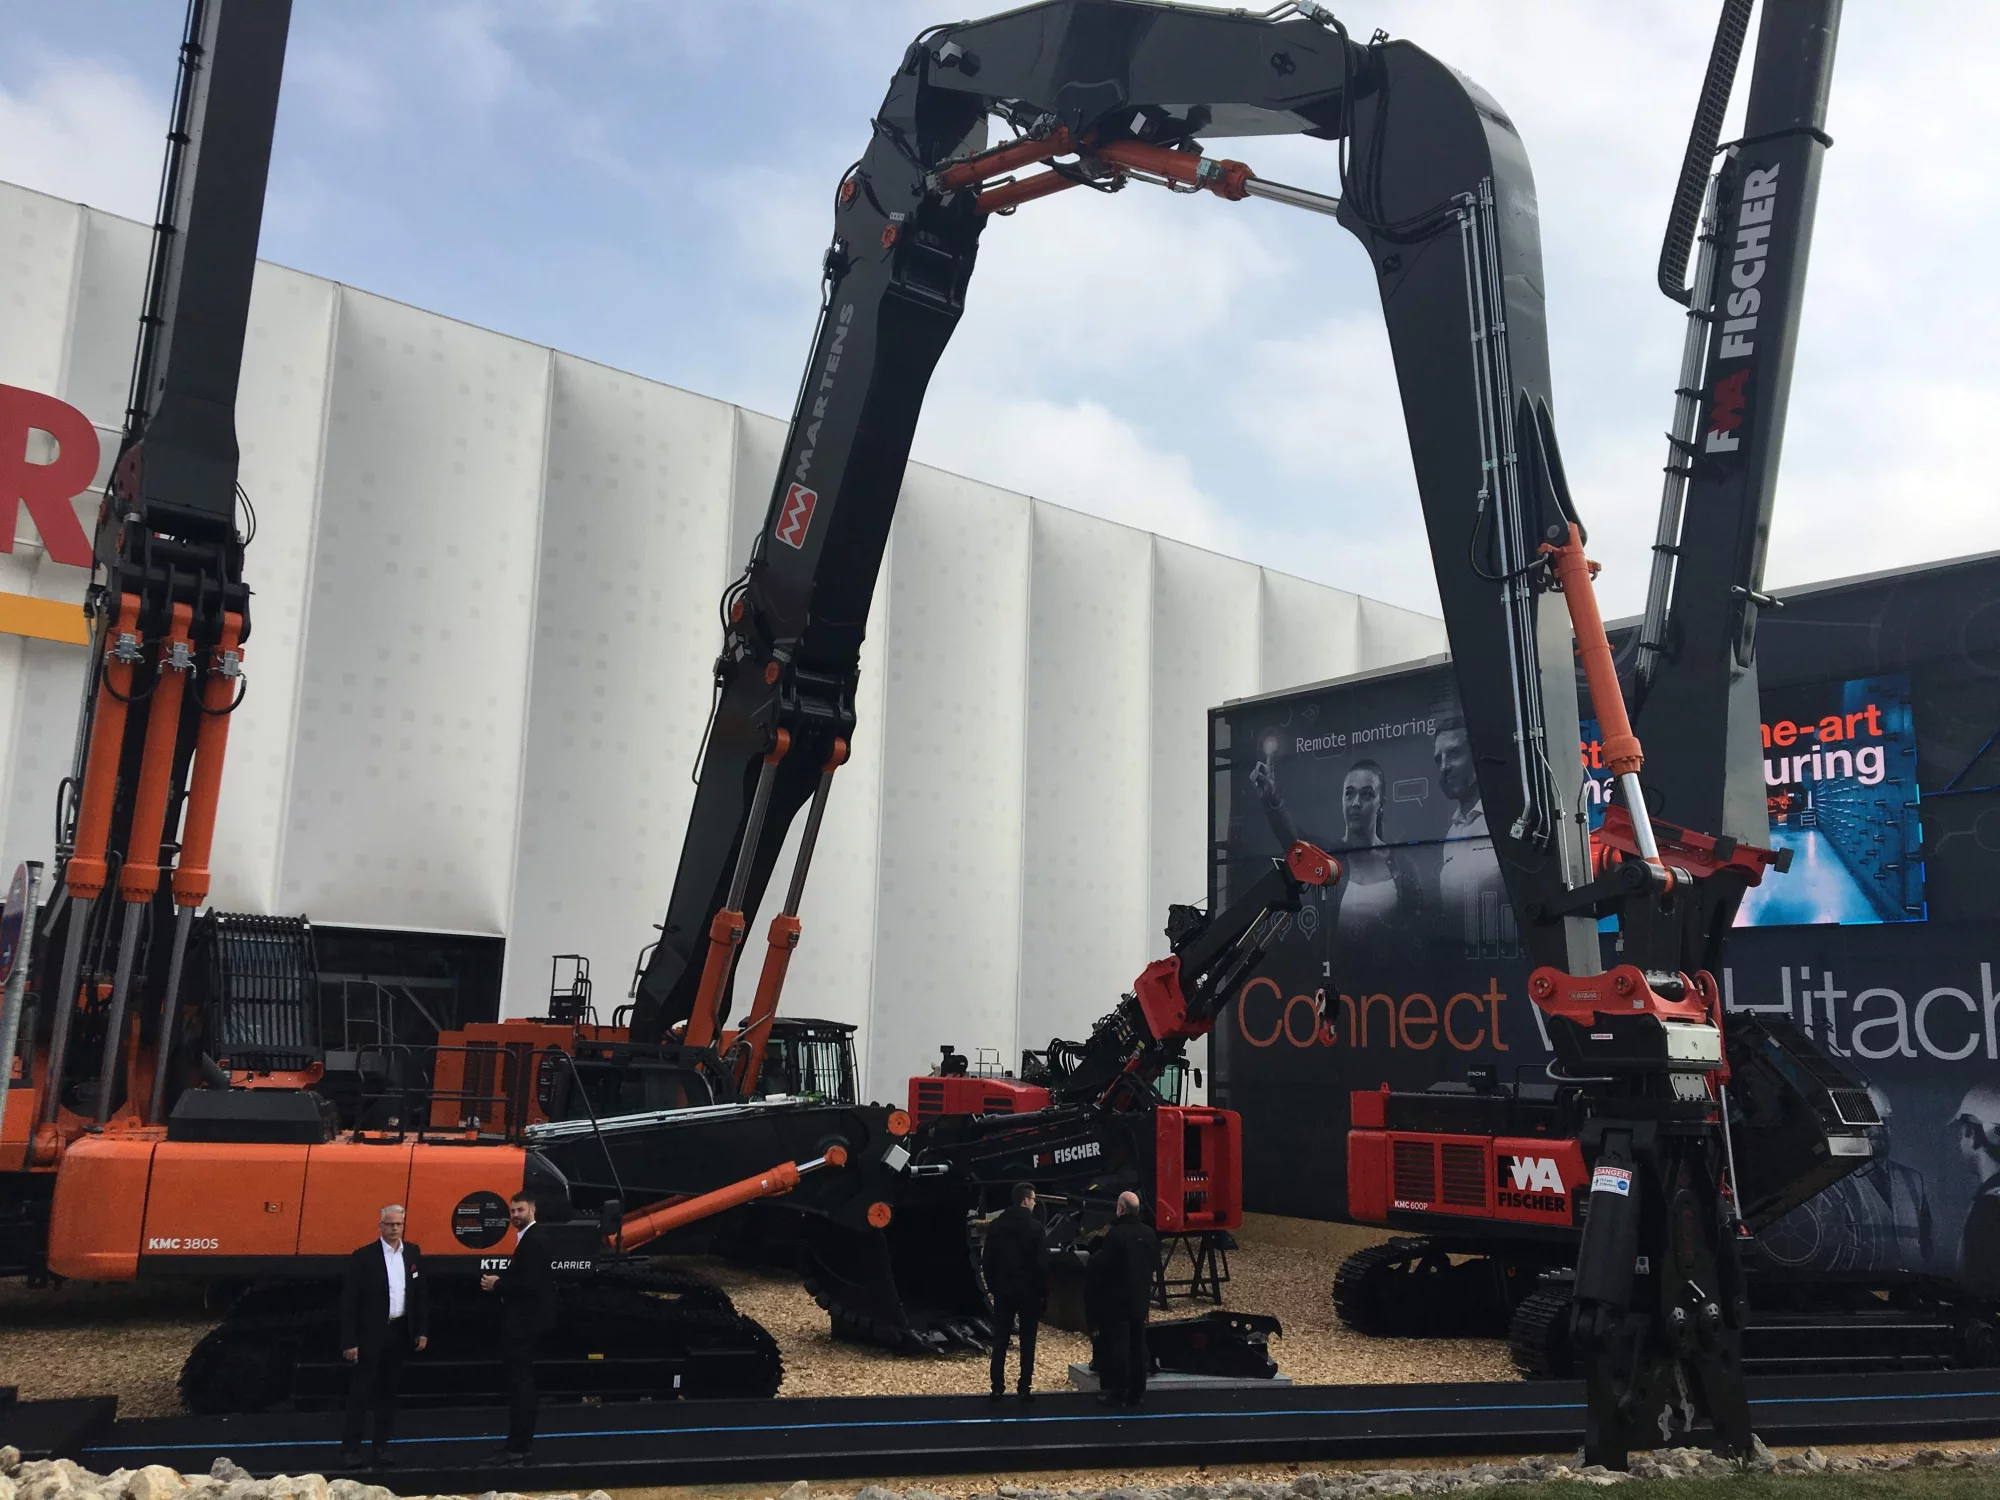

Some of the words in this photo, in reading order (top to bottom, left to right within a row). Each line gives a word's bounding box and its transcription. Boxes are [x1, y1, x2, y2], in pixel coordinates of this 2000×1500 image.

[1719, 162, 1780, 359] FISCHER
[795, 303, 854, 482] MARTENS
[1296, 732, 1346, 753] Remote
[1352, 718, 1437, 745] monitoring
[1054, 1141, 1101, 1164] FISCHER
[1596, 1168, 1629, 1179] DANGER
[1395, 1200, 1410, 1210] KMC
[1411, 1201, 1428, 1211] 600P
[1498, 1191, 1566, 1213] FISCHER
[148, 1238, 181, 1249] KMC
[182, 1238, 219, 1249] 380S
[480, 1259, 512, 1270] KTE
[550, 1261, 591, 1270] CARRIER
